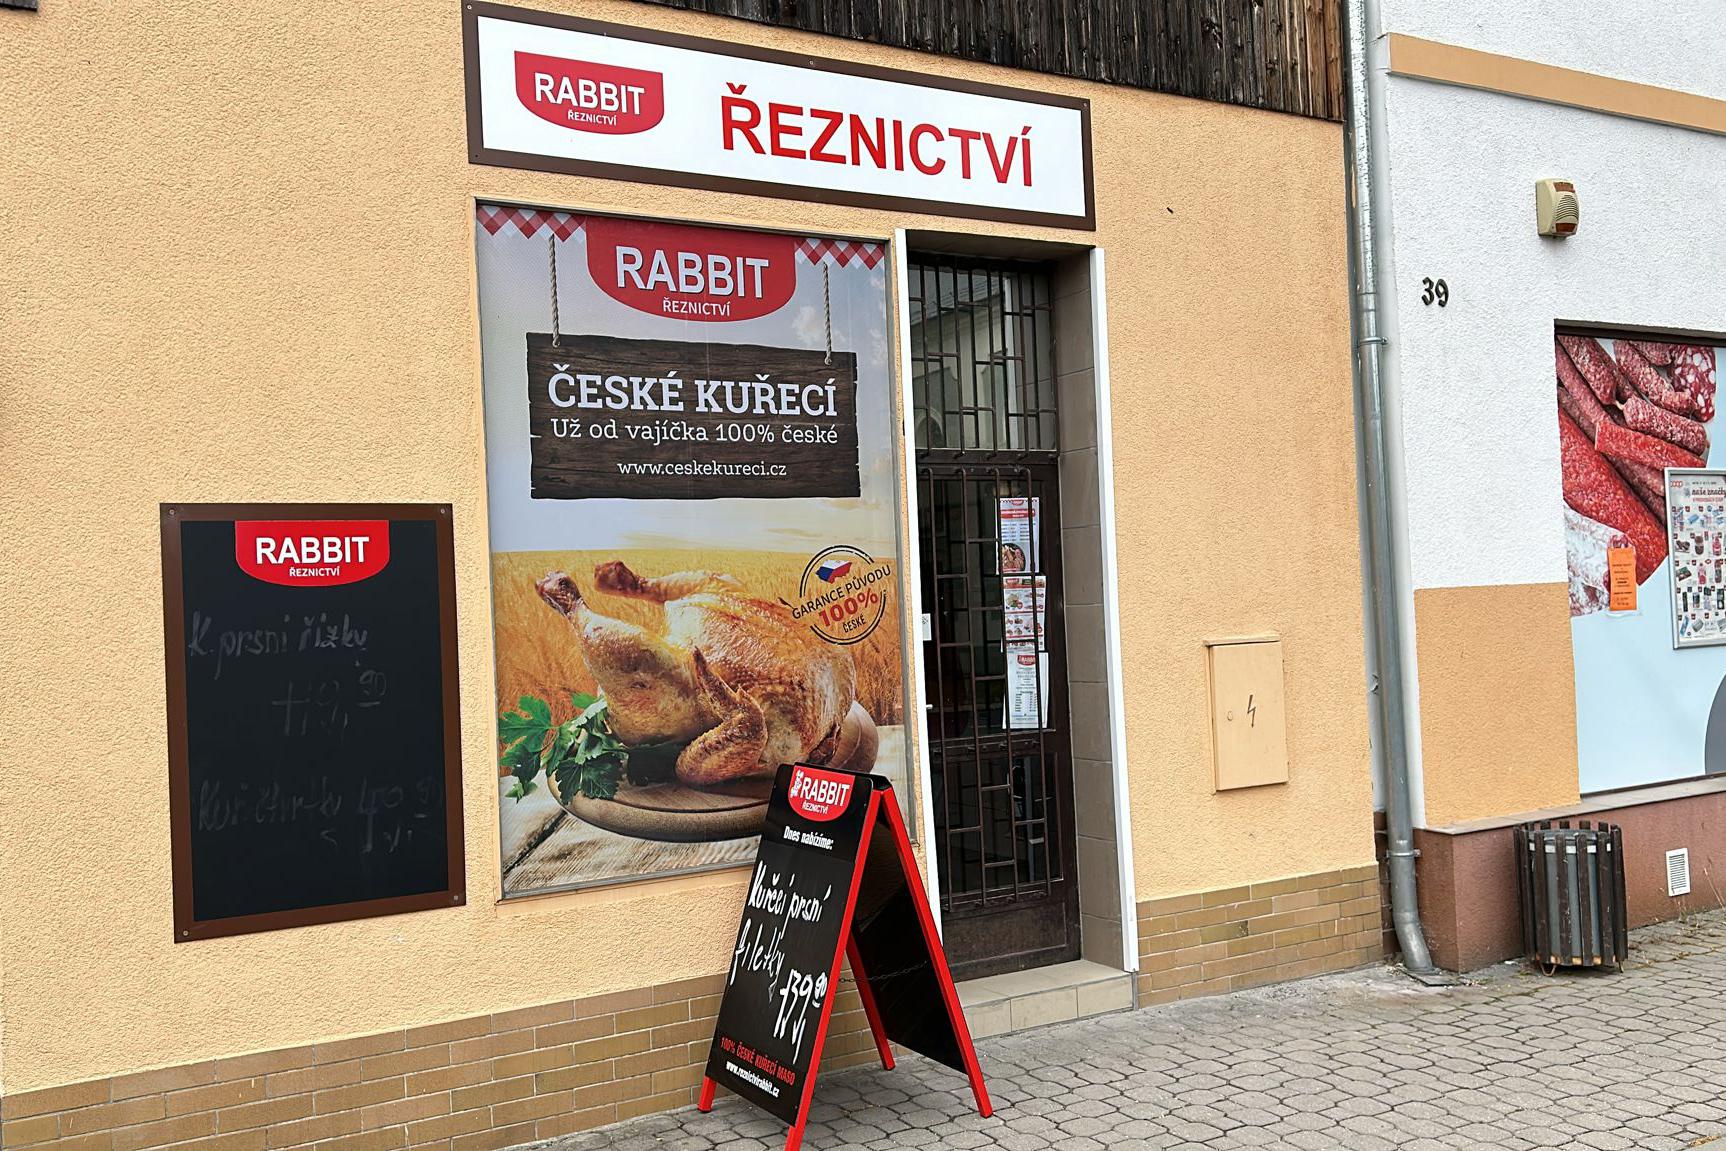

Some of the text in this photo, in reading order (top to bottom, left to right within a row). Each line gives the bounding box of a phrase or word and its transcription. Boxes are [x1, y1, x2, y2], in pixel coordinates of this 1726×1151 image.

[534, 72, 646, 116] RABBIT
[566, 109, 618, 127] ŘEZNICTVÍ
[721, 82, 1033, 187] ŘEZNICTVÍ
[615, 245, 771, 299] RABBIT
[1421, 276, 1449, 308] 39
[662, 297, 732, 318] ŘEZNICTVÍ
[547, 363, 838, 417] ČESKÉ KUŘECÍ
[550, 417, 839, 446] Už od vajíčka 100% české
[617, 459, 787, 477] www.ceskekureci.cz
[255, 536, 370, 565] RABBIT
[288, 565, 340, 577] ŘEZNICTVÍ
[792, 564, 891, 620] GARANCE PŮVODU
[818, 587, 879, 628] 100%
[842, 614, 867, 633] ČESKÉ
[800, 777, 850, 807] RABBIT
[801, 800, 829, 815] ŘEZNICTVÍ
[783, 825, 834, 851] Dnes nabízíme:
[720, 1036, 796, 1086] 100% ČESKÉ KUŘECÍ MASO
